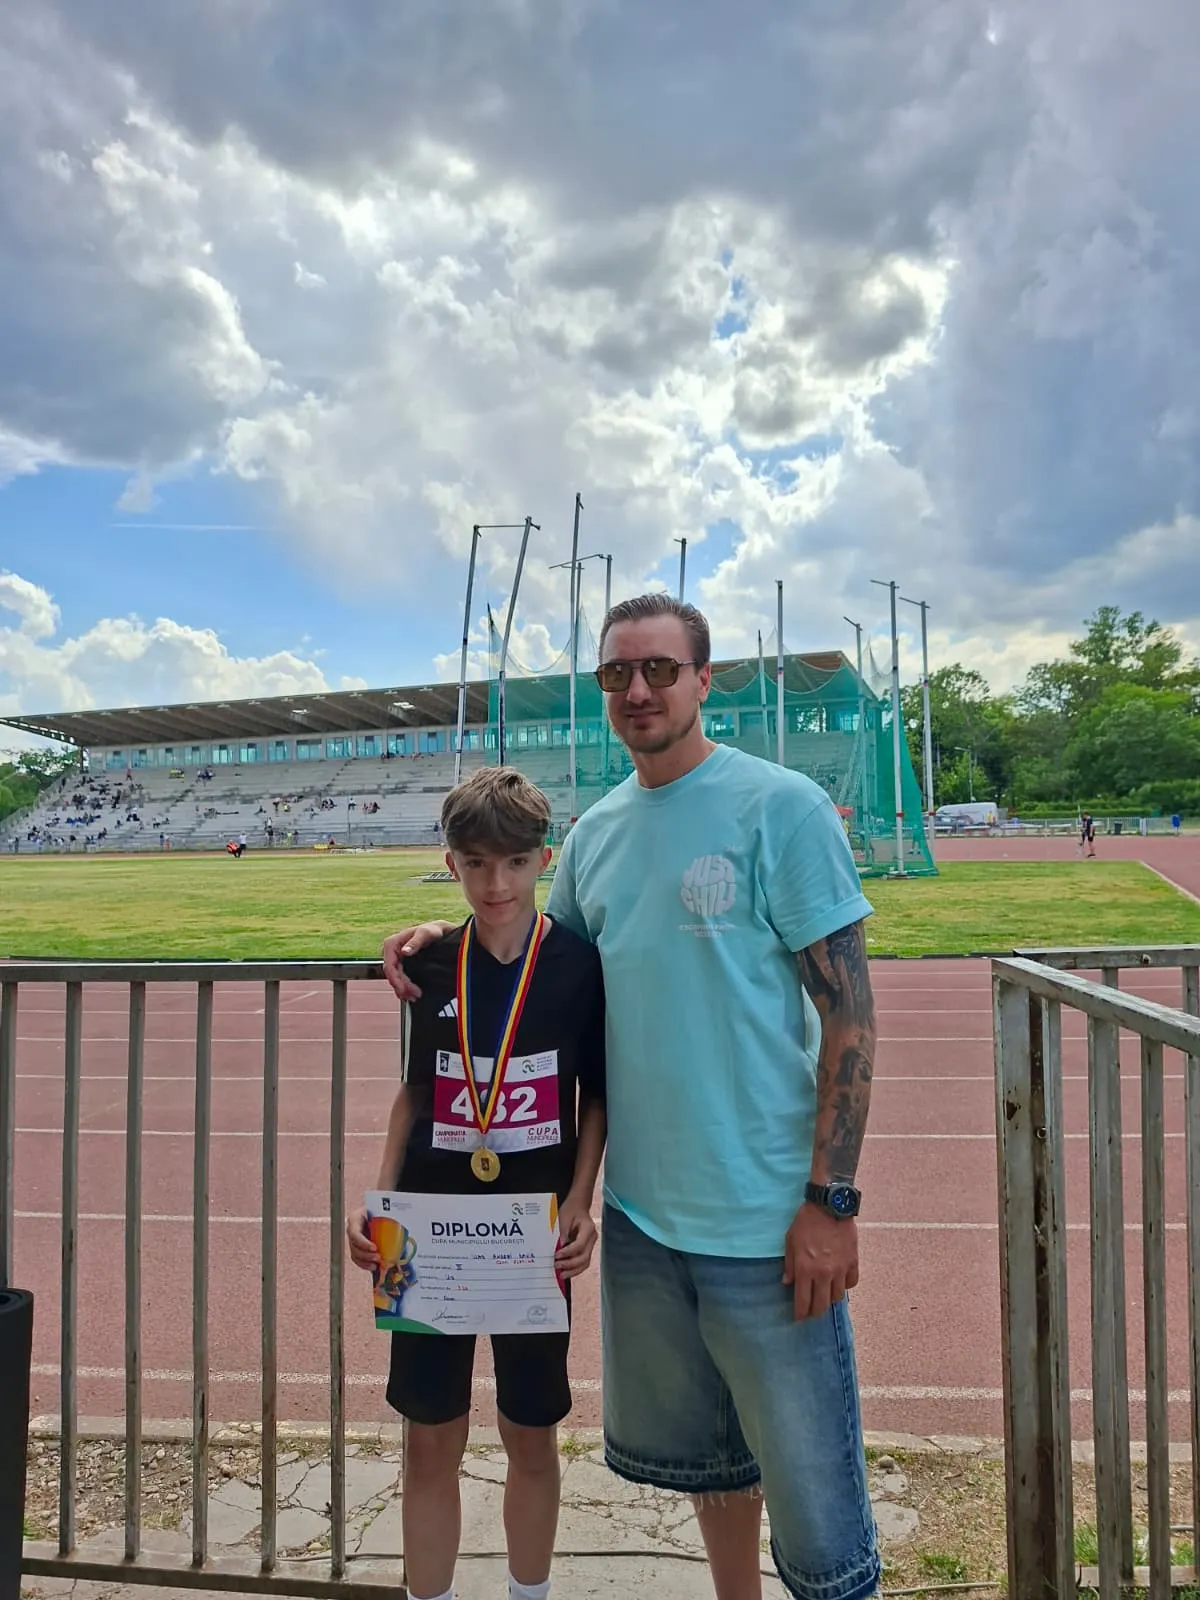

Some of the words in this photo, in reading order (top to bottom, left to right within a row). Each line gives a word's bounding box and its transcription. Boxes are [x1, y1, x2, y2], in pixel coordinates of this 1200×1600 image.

[682, 854, 736, 889] JUST
[681, 880, 736, 917] CHILL
[528, 1127, 559, 1136] CUPA
[431, 1218, 524, 1237] DIPLOMĂ
